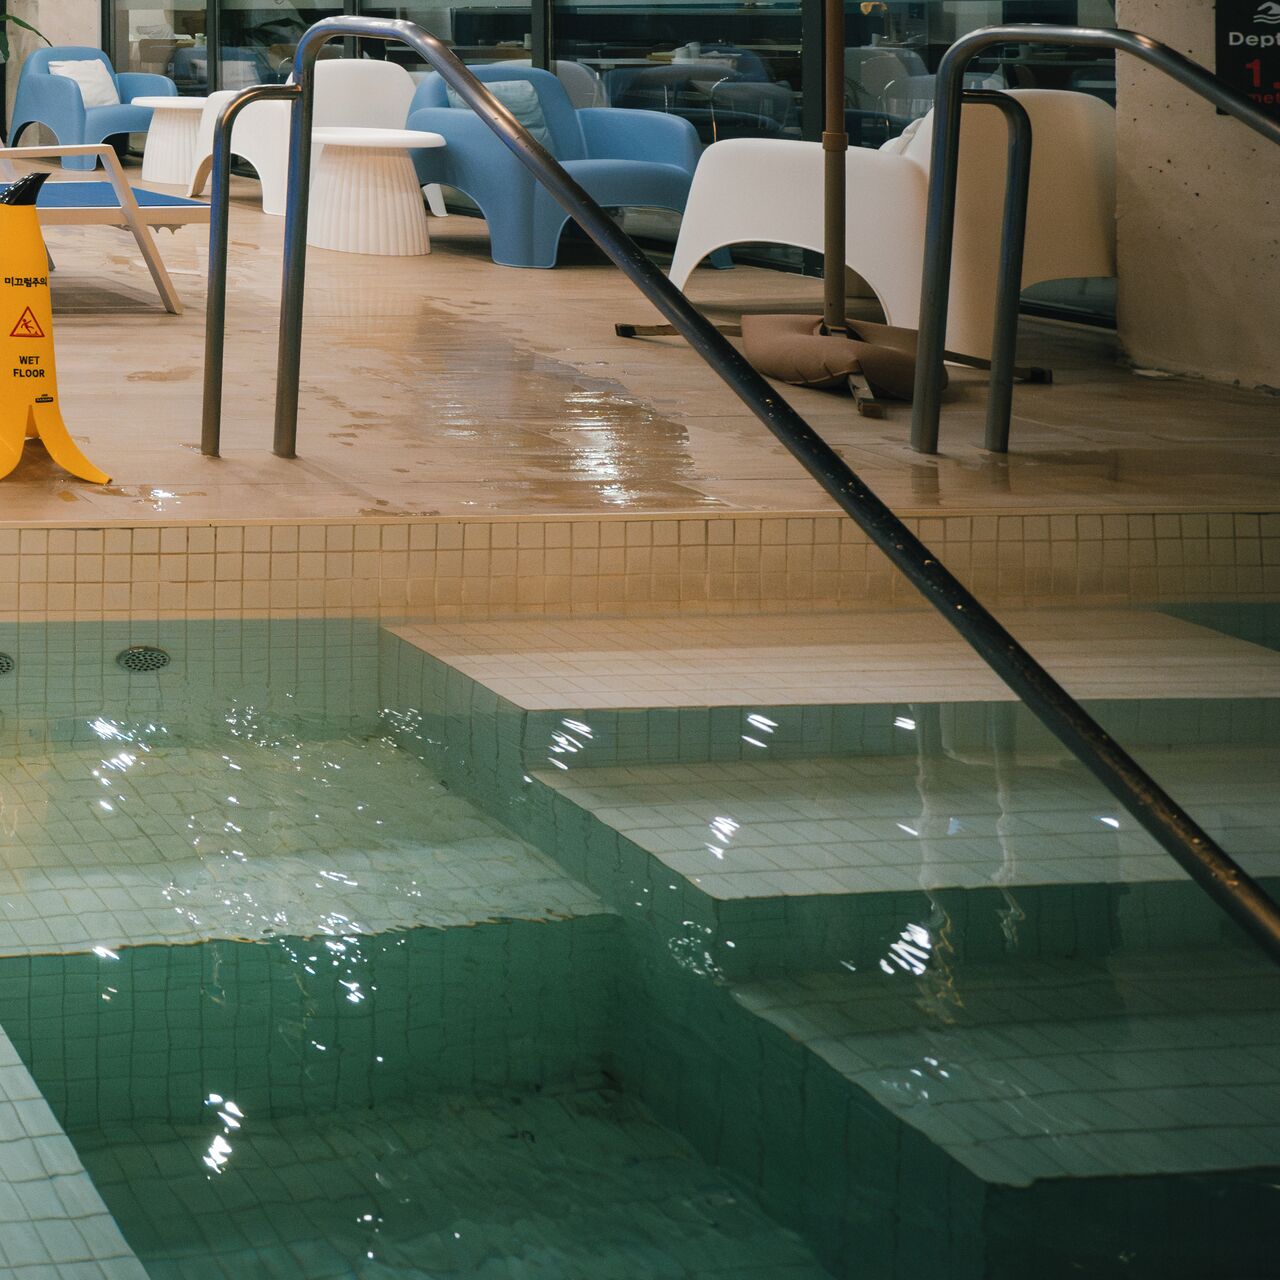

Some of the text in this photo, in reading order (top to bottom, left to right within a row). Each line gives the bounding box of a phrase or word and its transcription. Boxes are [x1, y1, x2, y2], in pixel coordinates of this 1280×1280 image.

[4, 275, 47, 288] 미끄럼주의
[19, 355, 40, 365] WET
[13, 368, 45, 378] FLOOR
